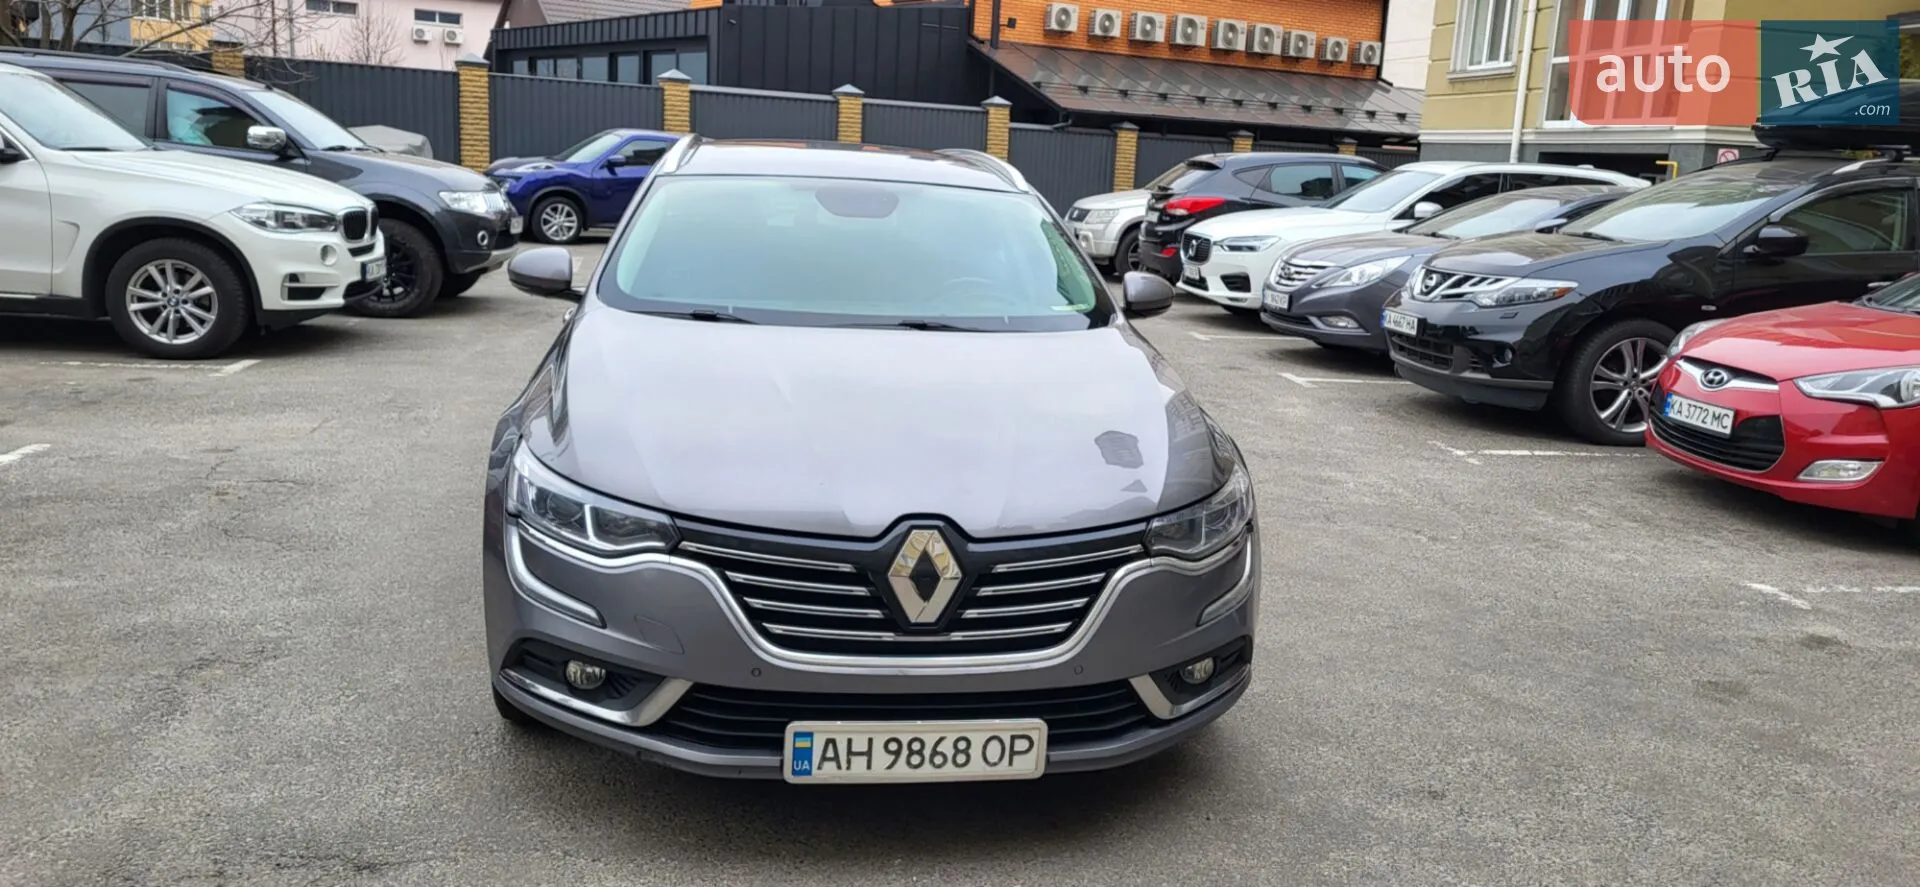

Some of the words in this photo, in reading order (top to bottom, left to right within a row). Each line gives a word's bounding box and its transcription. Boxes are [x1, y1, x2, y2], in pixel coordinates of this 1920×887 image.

[1670, 399, 1683, 417] KA
[1685, 404, 1709, 424] 3772
[1711, 411, 1730, 429] MC
[793, 761, 811, 772] UA
[816, 737, 874, 772] AH
[883, 736, 972, 769] 9868
[981, 734, 1035, 768] OP
